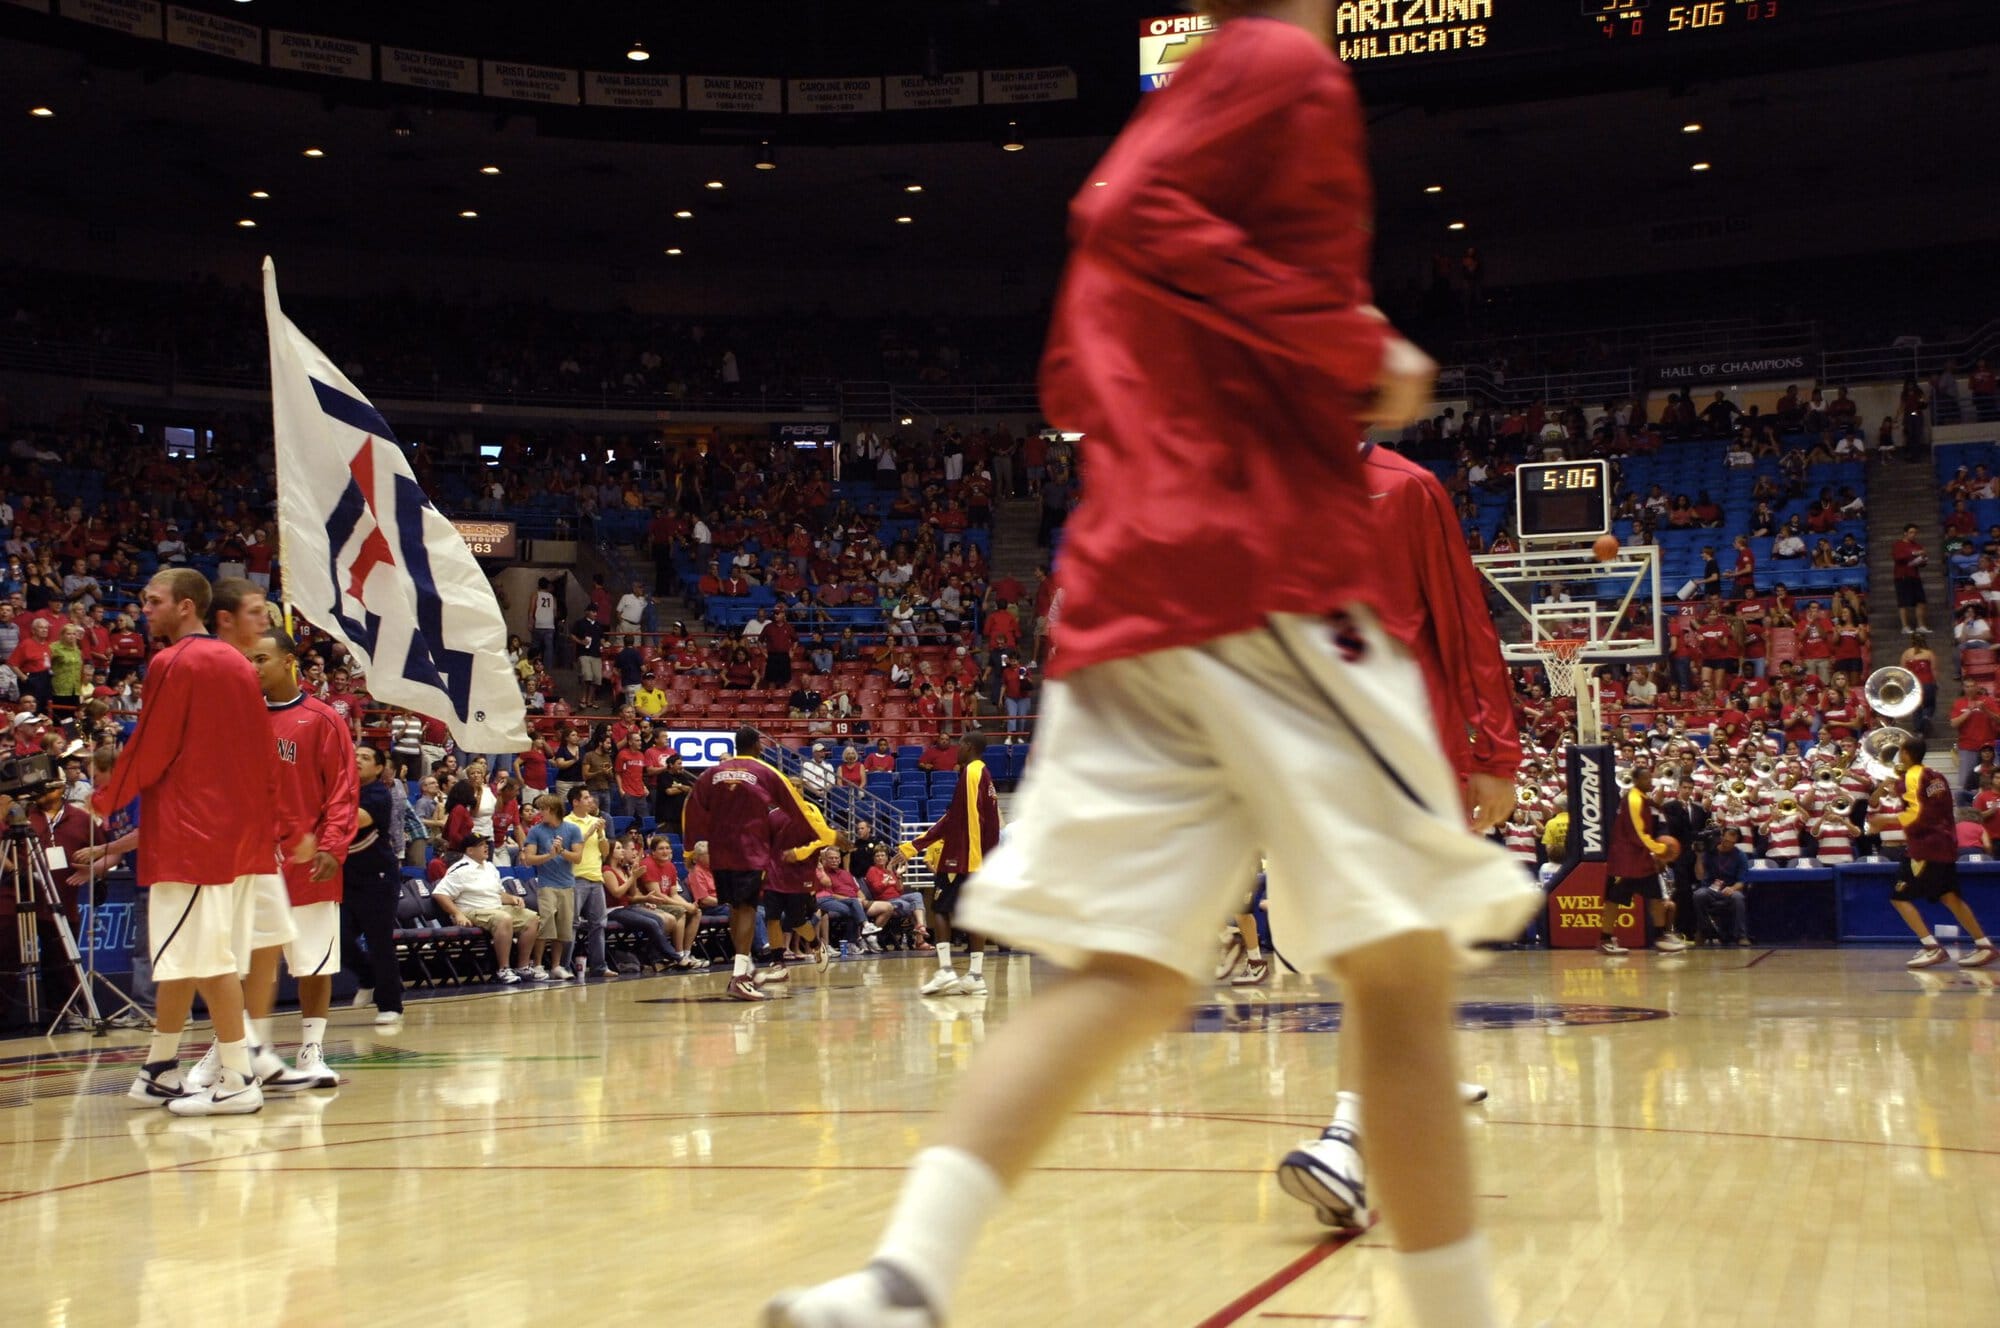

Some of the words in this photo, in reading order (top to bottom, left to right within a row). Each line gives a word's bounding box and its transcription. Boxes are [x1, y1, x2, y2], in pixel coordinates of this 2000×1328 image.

[1668, 2, 1726, 31] 5:06
[1150, 16, 1217, 35] O'RIE
[1339, 26, 1487, 62] WILDCATS
[704, 78, 730, 88] DIANE
[733, 79, 764, 90] MONTY
[844, 80, 869, 89] WOOD
[1661, 368, 1694, 378] HALL
[1700, 364, 1716, 375] OF
[1721, 357, 1804, 374] CHAMPIONS
[781, 425, 830, 435] PEPSI
[1543, 468, 1596, 490] 5:06
[541, 598, 551, 608] 21
[1681, 606, 1694, 615] 21
[836, 723, 848, 734] 19
[1580, 753, 1602, 855] ARIZONA
[1560, 913, 1634, 928] FARO
